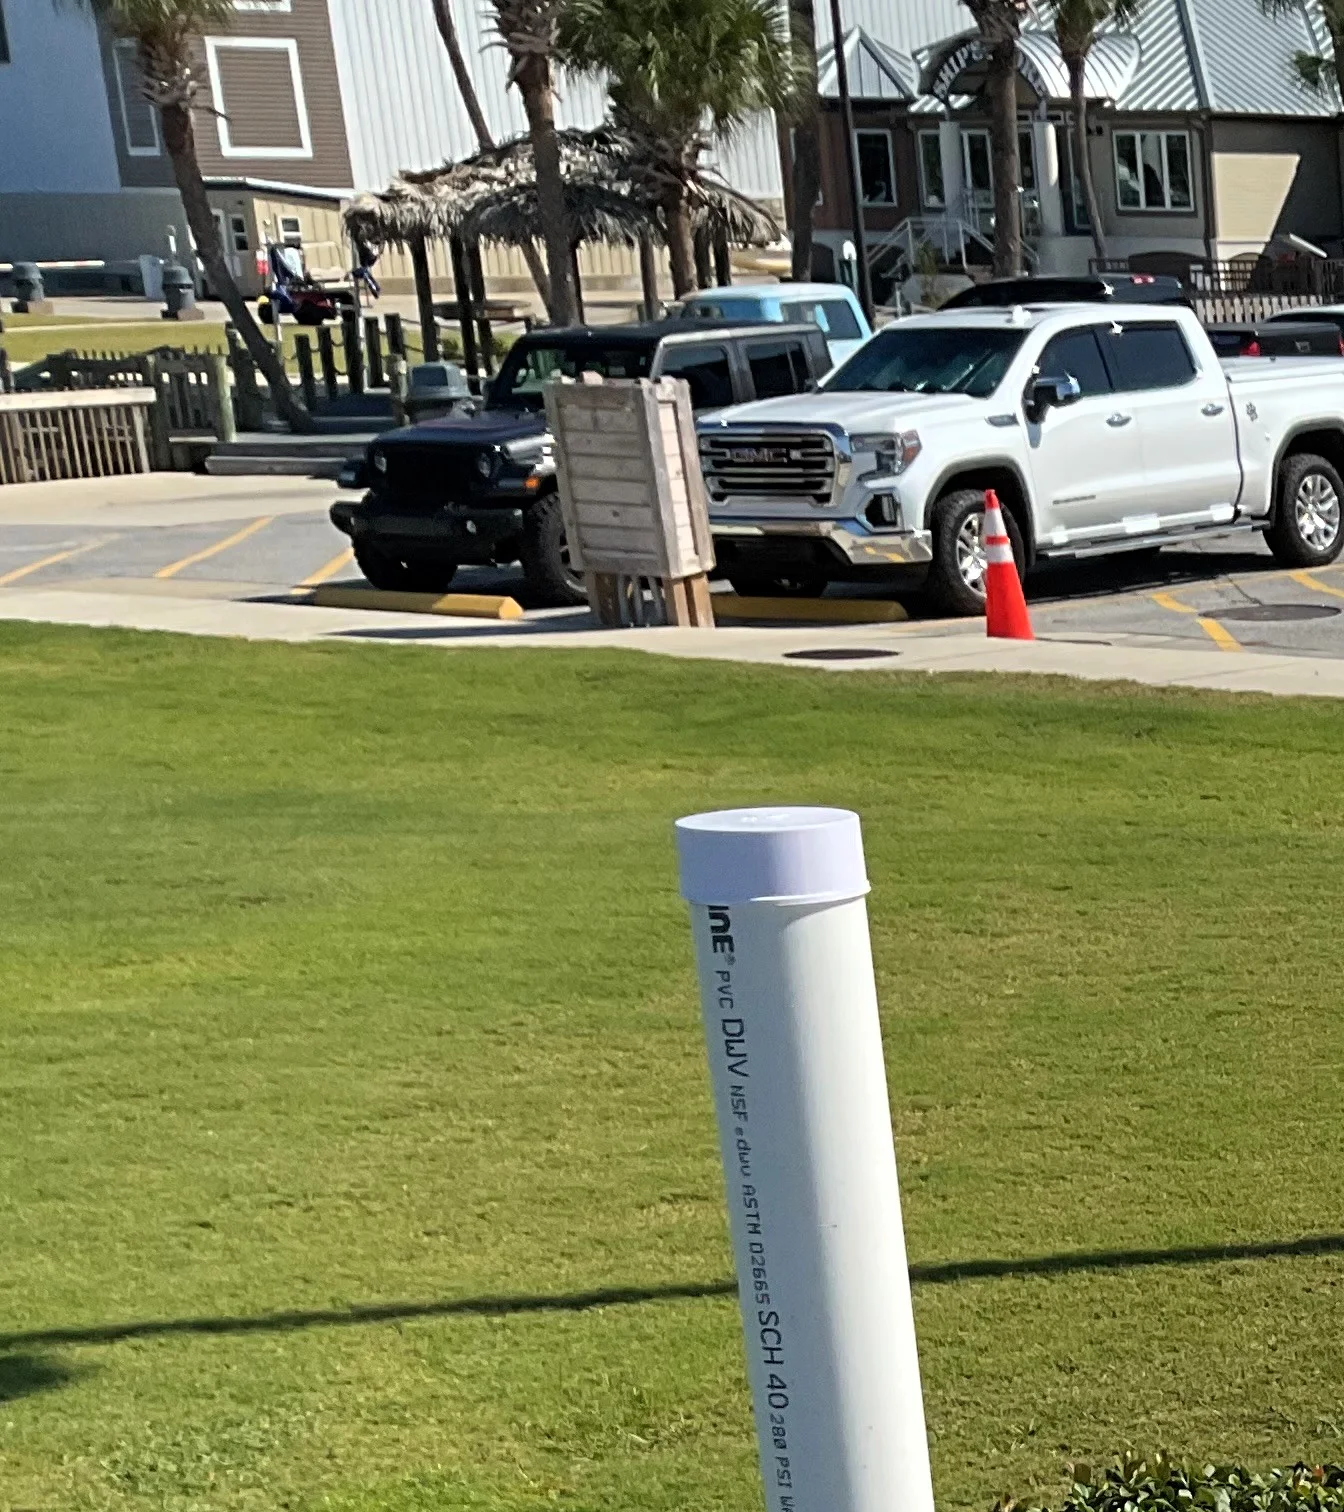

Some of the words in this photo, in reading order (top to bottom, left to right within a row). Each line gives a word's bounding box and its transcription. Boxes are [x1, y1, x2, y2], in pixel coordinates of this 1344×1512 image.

[714, 970, 734, 1011] PVC
[719, 1018, 750, 1078] DWV
[728, 1085, 749, 1123] NSF
[740, 1184, 762, 1236] ASTM
[747, 1242, 771, 1306] D2665
[756, 1310, 785, 1366] SCH
[764, 1373, 789, 1411] 40
[768, 1413, 788, 1451] 280
[773, 1456, 793, 1490] PSI
